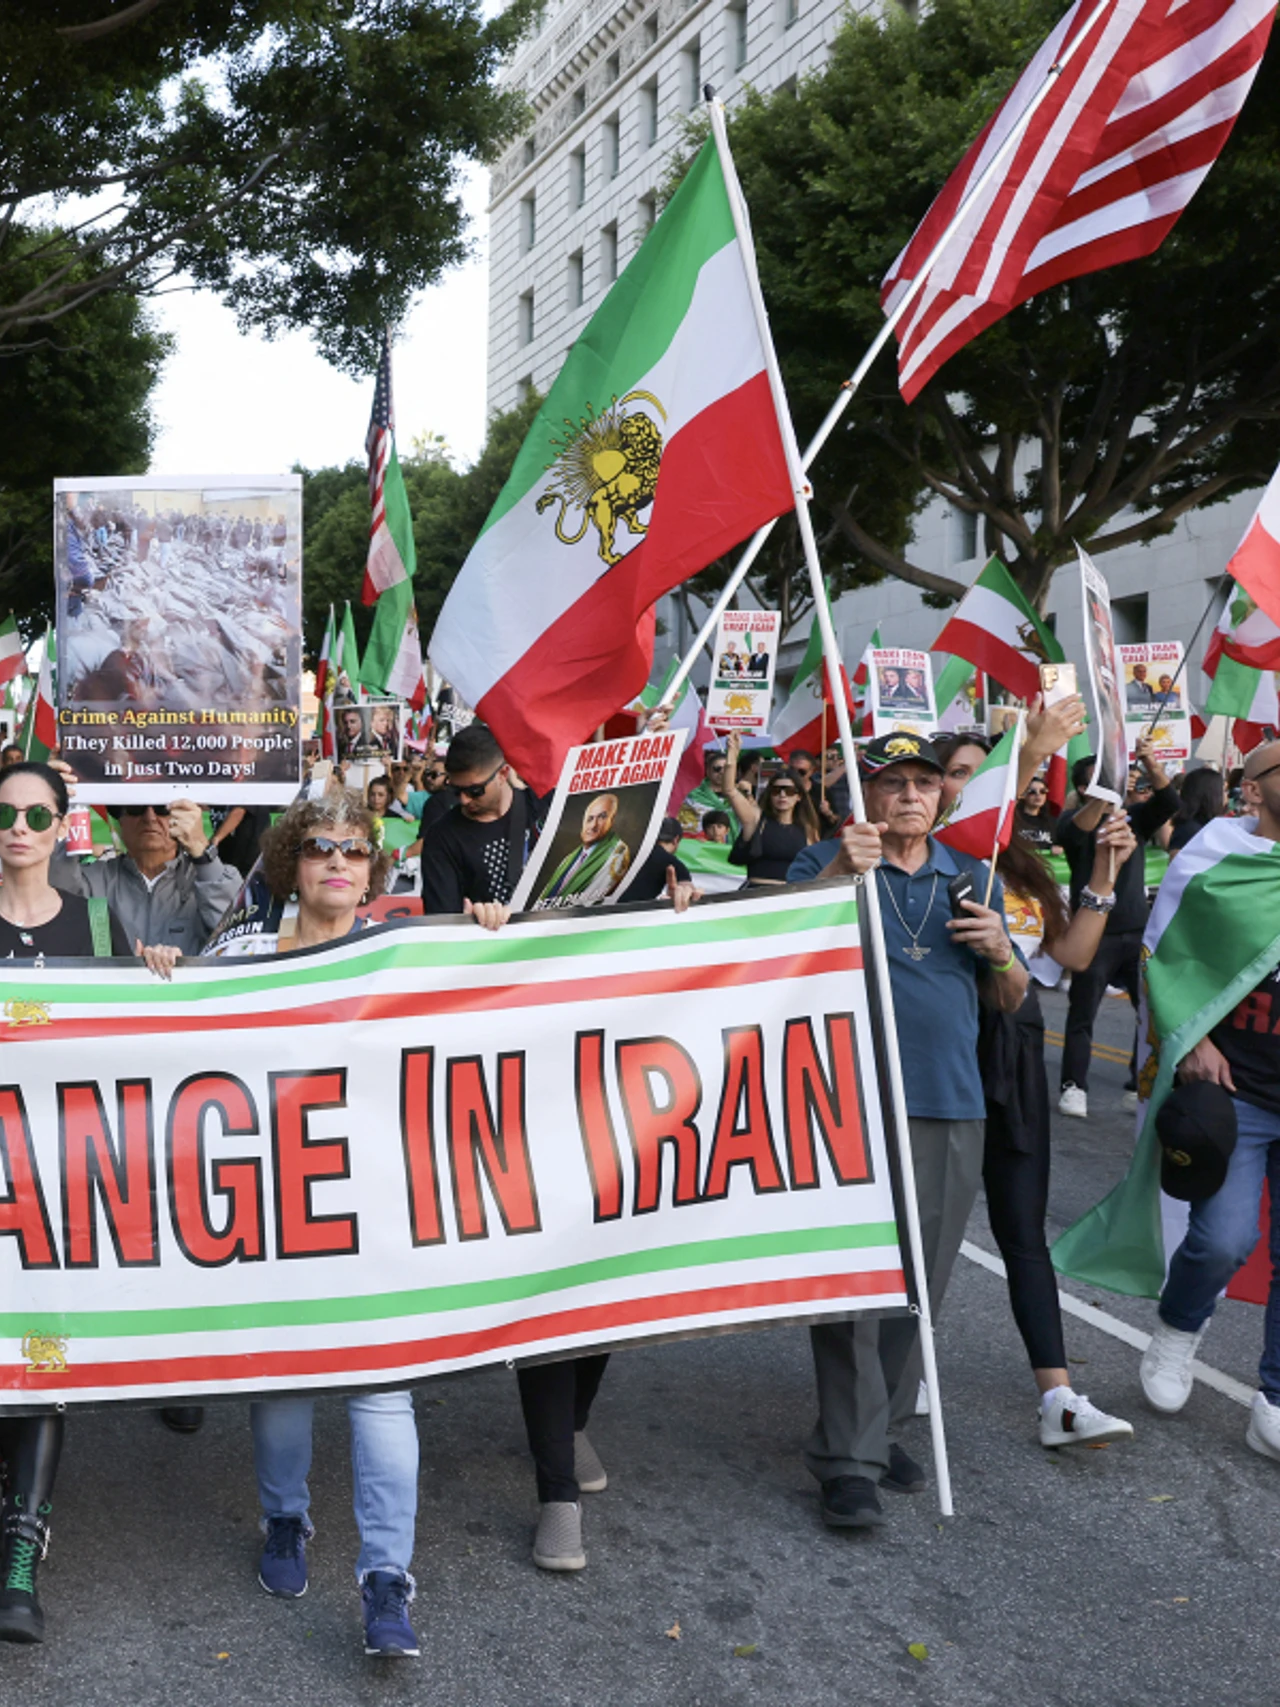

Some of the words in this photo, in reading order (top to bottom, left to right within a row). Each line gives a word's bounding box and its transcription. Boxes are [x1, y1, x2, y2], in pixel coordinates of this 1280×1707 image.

[59, 708, 118, 726] Crime
[122, 708, 197, 729] Against
[200, 707, 298, 728] Humanity
[64, 734, 108, 753] They
[112, 734, 166, 750] Killed
[171, 734, 227, 752] 12,000
[232, 734, 294, 752] People
[574, 742, 629, 771] MAKE
[630, 734, 676, 762] IRAN
[104, 761, 123, 776] in
[125, 761, 162, 779] Just
[164, 761, 204, 776] Two
[207, 761, 256, 779] Days!
[569, 767, 620, 792] GREAT
[618, 760, 668, 785] AGAIN
[400, 1045, 543, 1249] IN
[574, 1011, 876, 1225] IRAN
